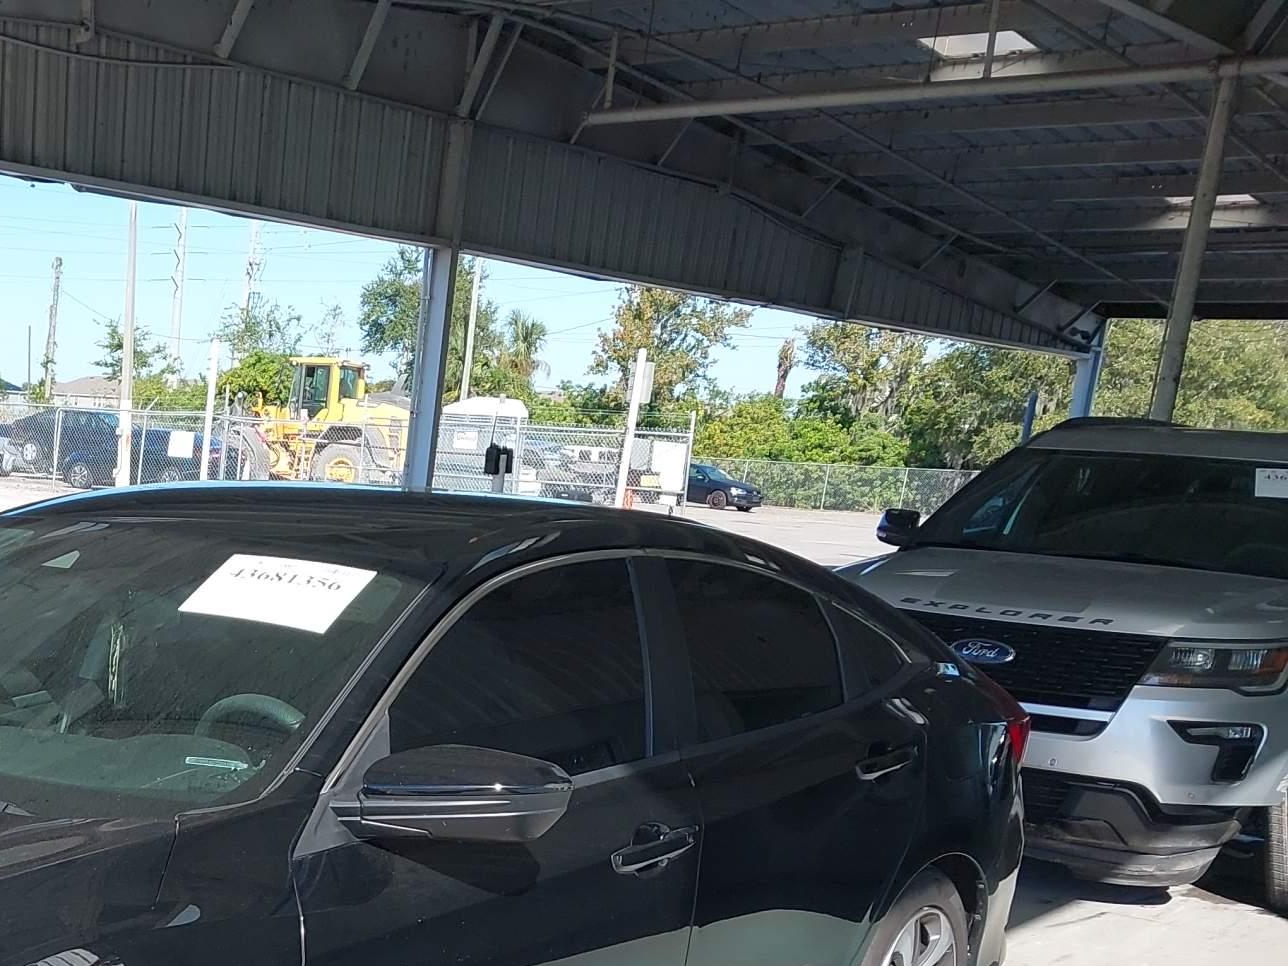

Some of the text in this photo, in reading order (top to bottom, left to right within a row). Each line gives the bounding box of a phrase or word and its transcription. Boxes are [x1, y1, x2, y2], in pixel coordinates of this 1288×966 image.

[229, 566, 342, 593] 43681356
[899, 597, 1115, 625] EXPLORER
[961, 640, 998, 658] Ford
